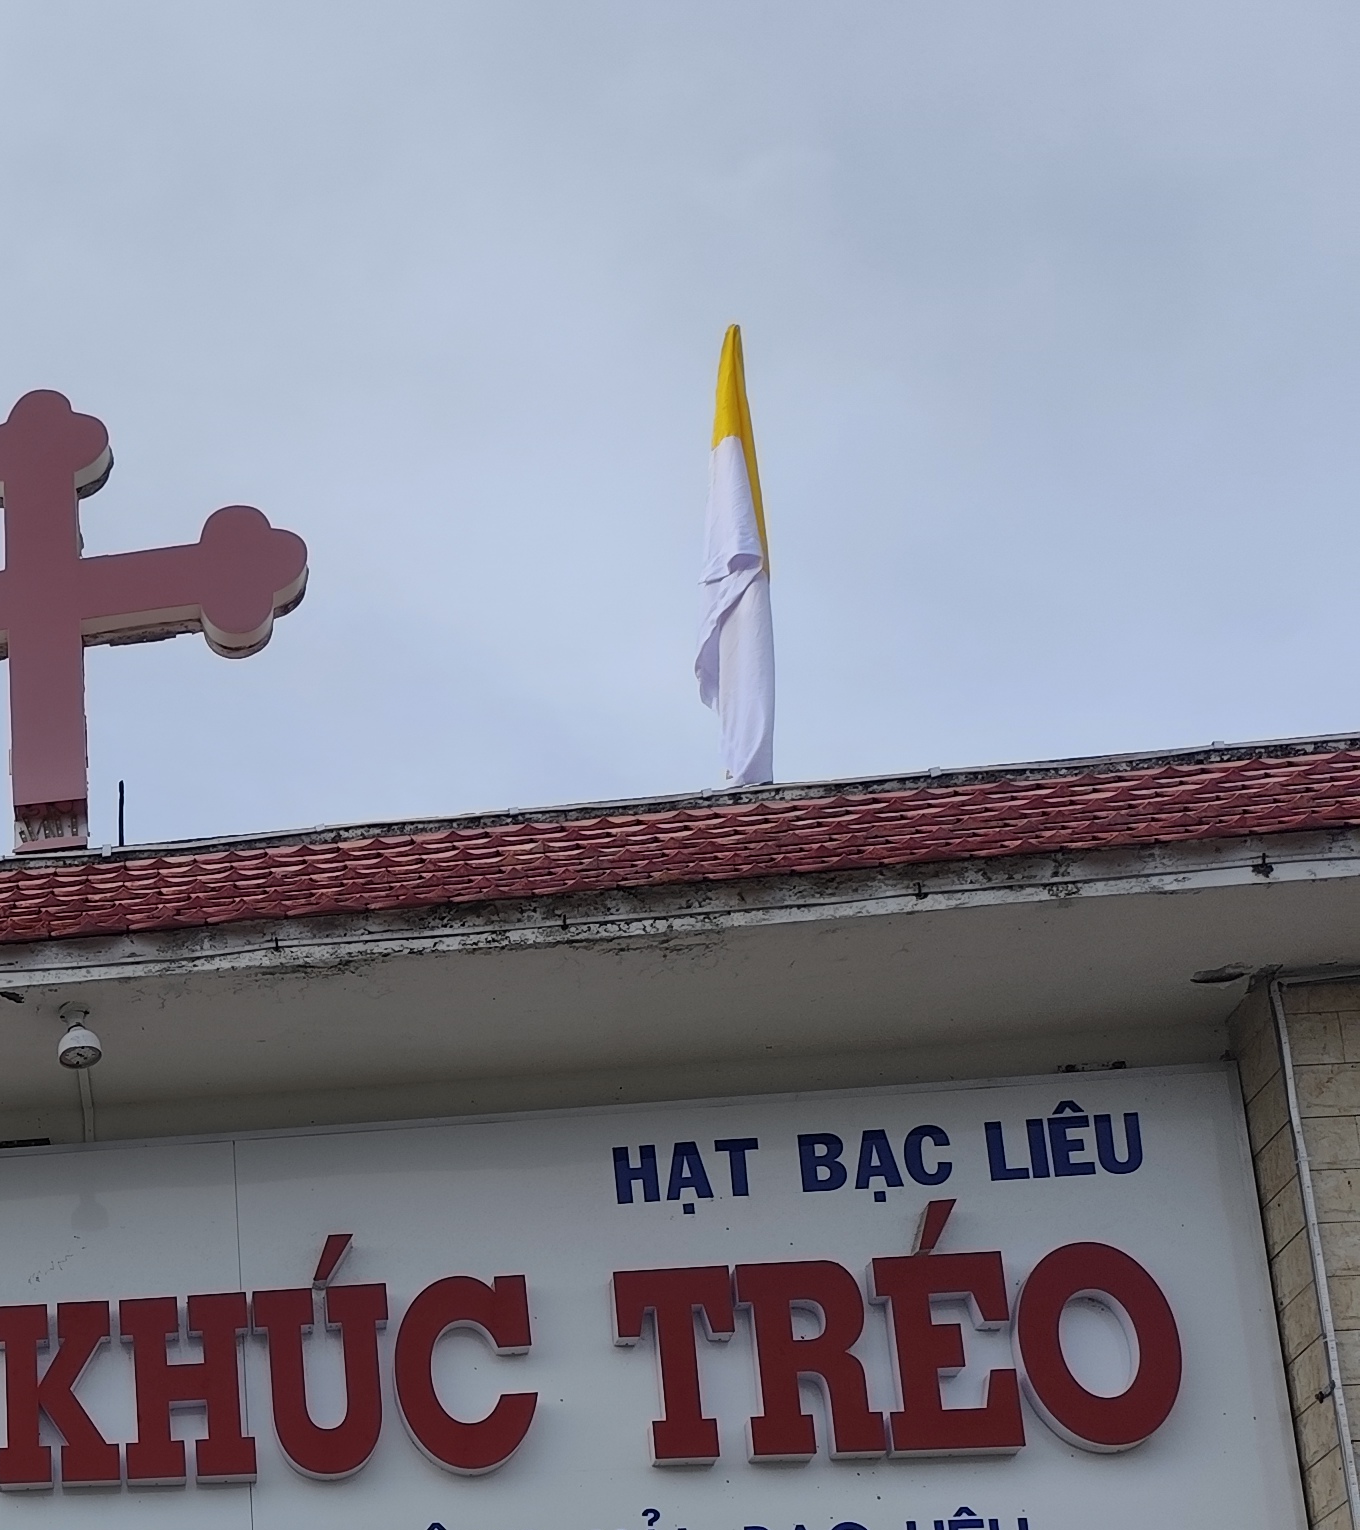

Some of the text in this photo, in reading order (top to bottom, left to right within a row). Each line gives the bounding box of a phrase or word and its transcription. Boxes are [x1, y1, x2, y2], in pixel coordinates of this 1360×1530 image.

[612, 1100, 1144, 1214] HẠT BẠC LIÊU
[610, 1198, 1182, 1465] TRÉO
